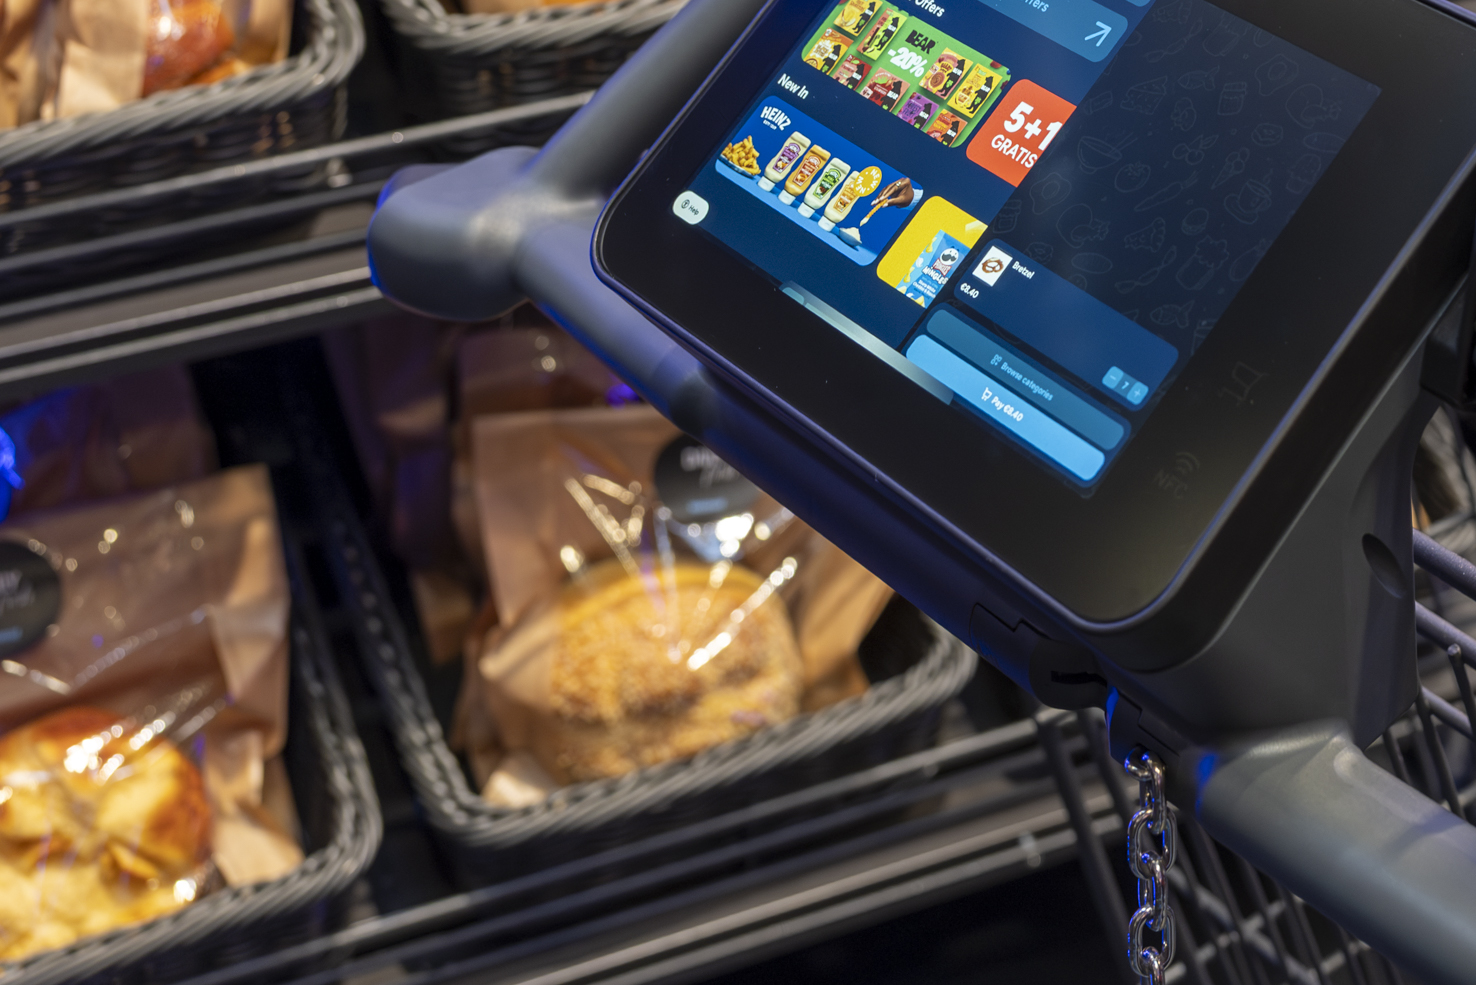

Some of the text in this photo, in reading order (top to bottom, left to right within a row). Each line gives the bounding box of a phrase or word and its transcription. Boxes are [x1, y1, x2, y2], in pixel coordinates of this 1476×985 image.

[905, 30, 936, 54] BEAR
[888, 47, 927, 78] -20%
[777, 73, 809, 99] New In
[760, 106, 791, 131] HEINZ
[1003, 101, 1062, 151] 5+1
[991, 134, 1038, 168] GRATIS
[688, 205, 699, 216] Help
[1012, 261, 1035, 279] Bretzel
[960, 283, 979, 299] €8.40
[1001, 362, 1053, 401] Browse categories
[991, 396, 1024, 422] Pay €8.40
